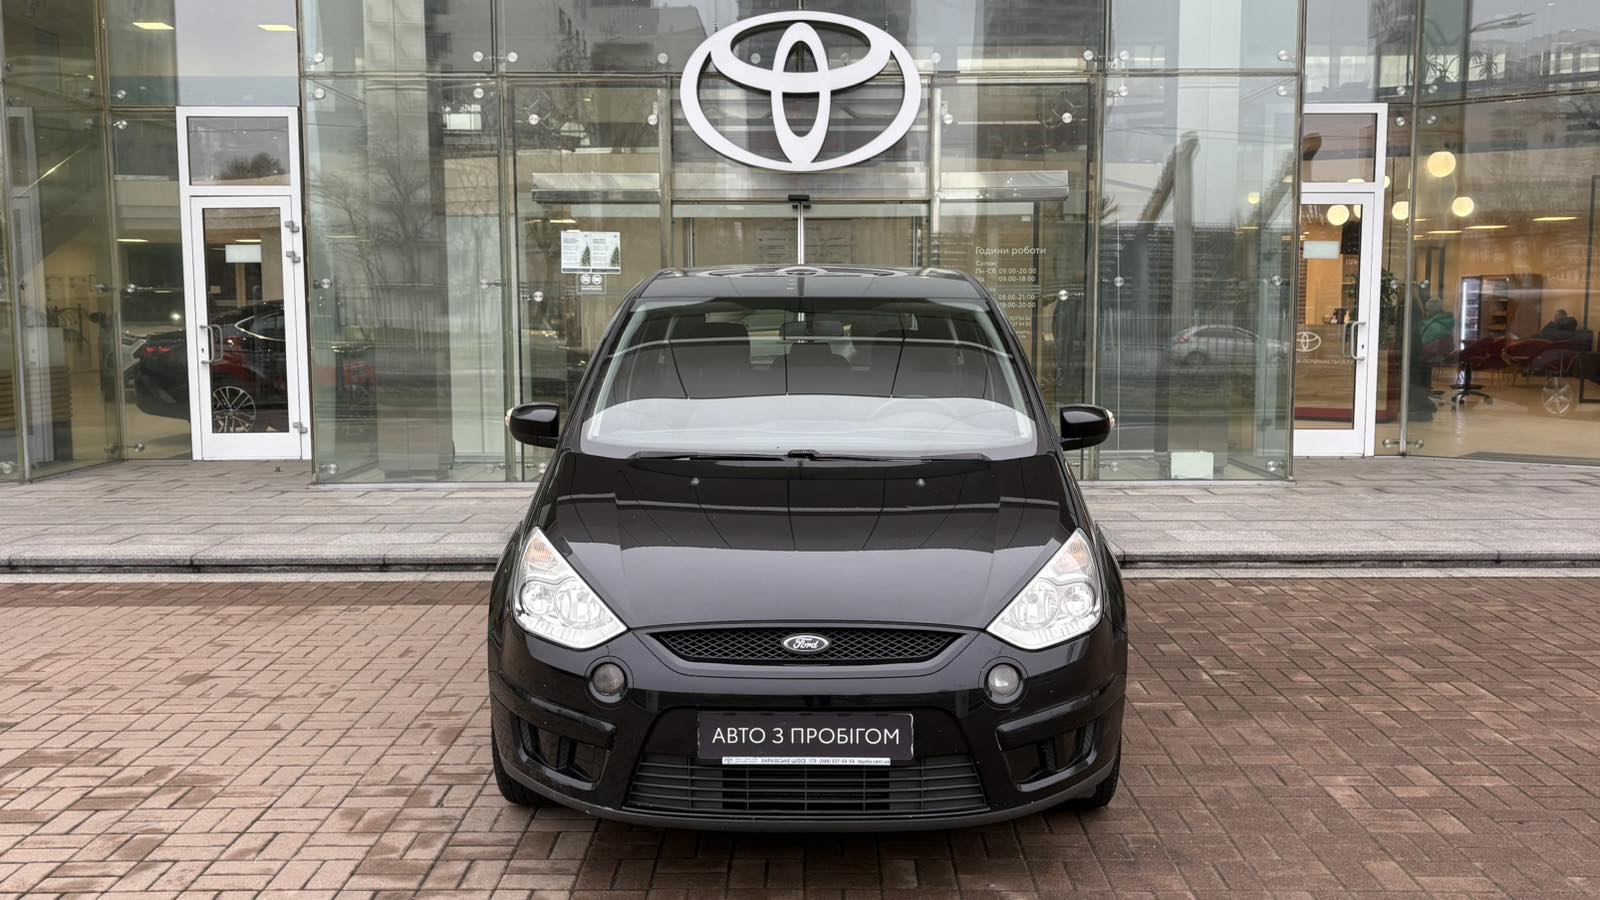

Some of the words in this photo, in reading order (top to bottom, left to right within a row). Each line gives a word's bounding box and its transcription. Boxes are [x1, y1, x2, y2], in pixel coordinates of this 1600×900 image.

[975, 246, 1009, 255] Години
[1011, 246, 1047, 256] роботи
[792, 637, 820, 649] Ford
[711, 727, 766, 744] АВТО
[771, 727, 784, 744] З
[791, 727, 900, 745] ПРОБІГОМ
